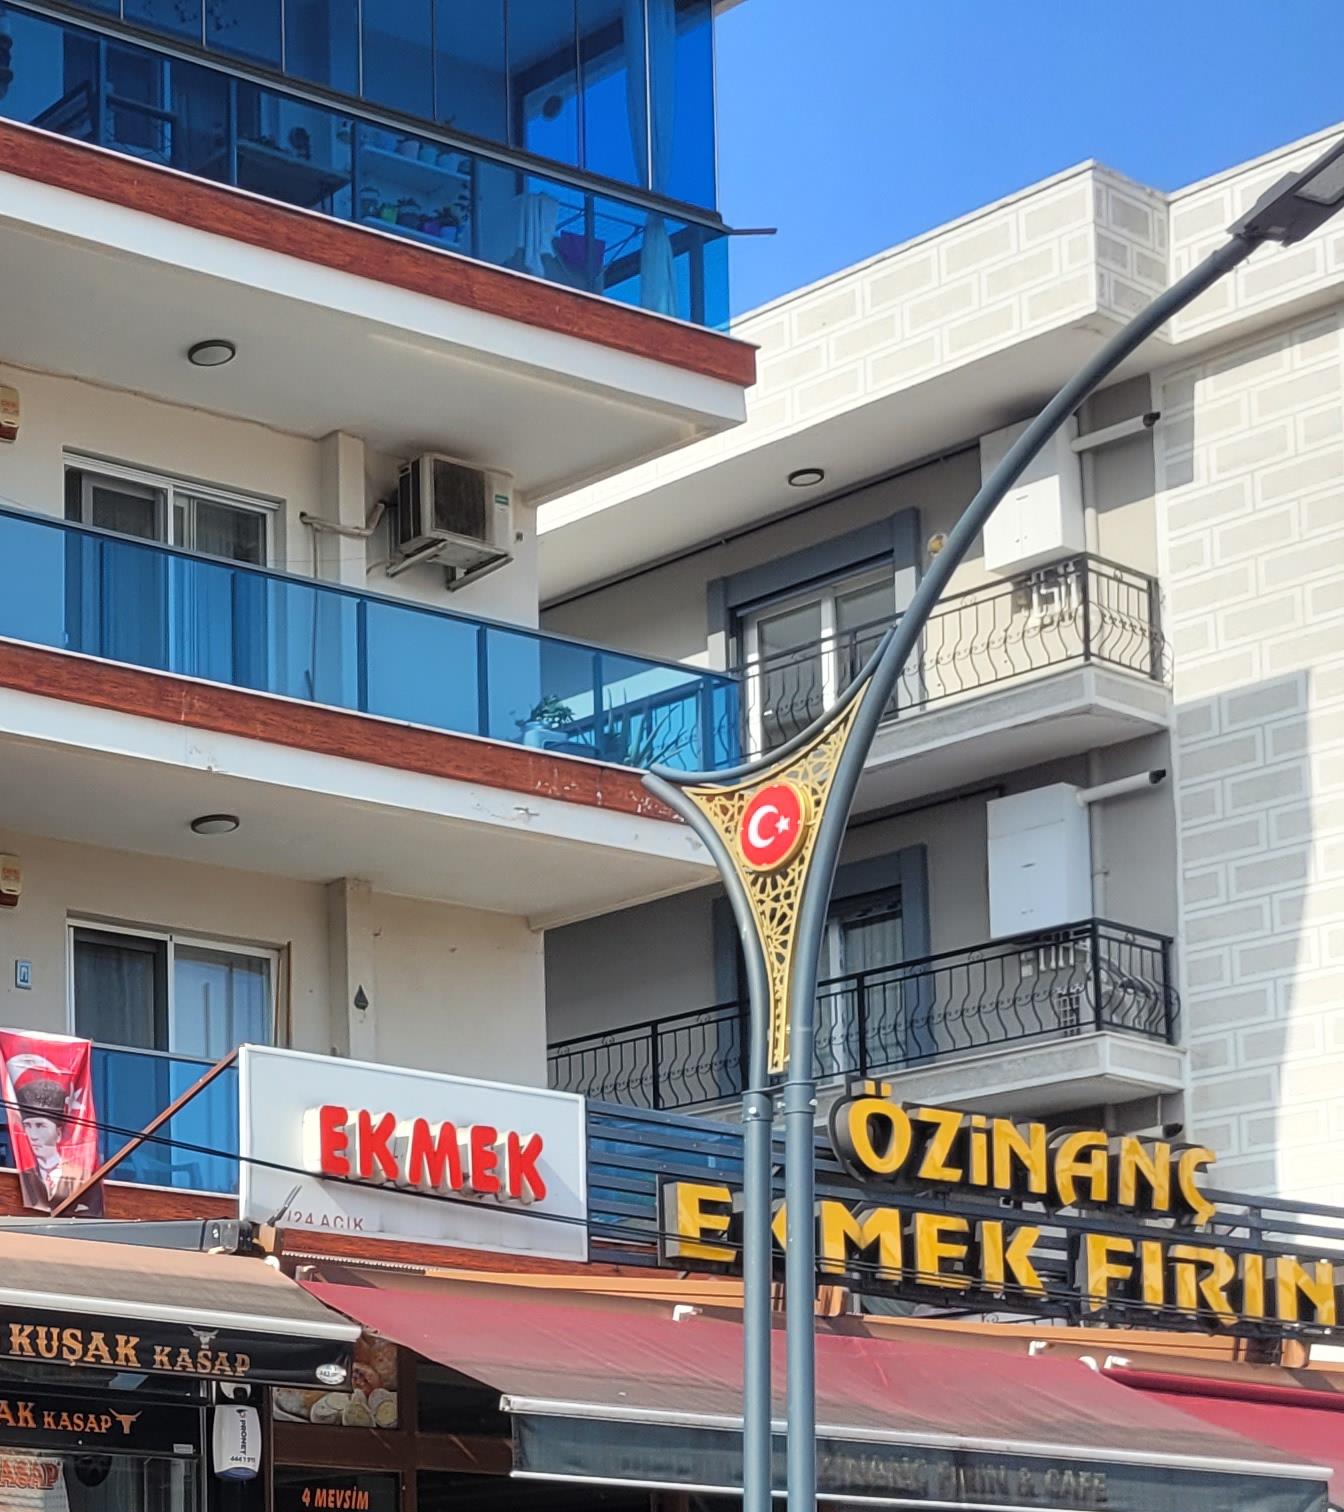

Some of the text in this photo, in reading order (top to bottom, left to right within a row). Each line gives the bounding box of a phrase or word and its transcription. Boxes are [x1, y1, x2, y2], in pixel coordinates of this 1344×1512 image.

[318, 1105, 547, 1202] EKMEK
[848, 1080, 1217, 1226] ÖZİNANÇ
[676, 1181, 1337, 1329] EMEK FIRIN
[8, 1323, 142, 1367] KUŞAK
[152, 1345, 251, 1378] KASAP
[42, 1411, 111, 1435] KASAP
[239, 1419, 247, 1456] PRONET
[302, 1486, 370, 1511] 4 MEVSİM
[1043, 1467, 1109, 1502] CAFE
